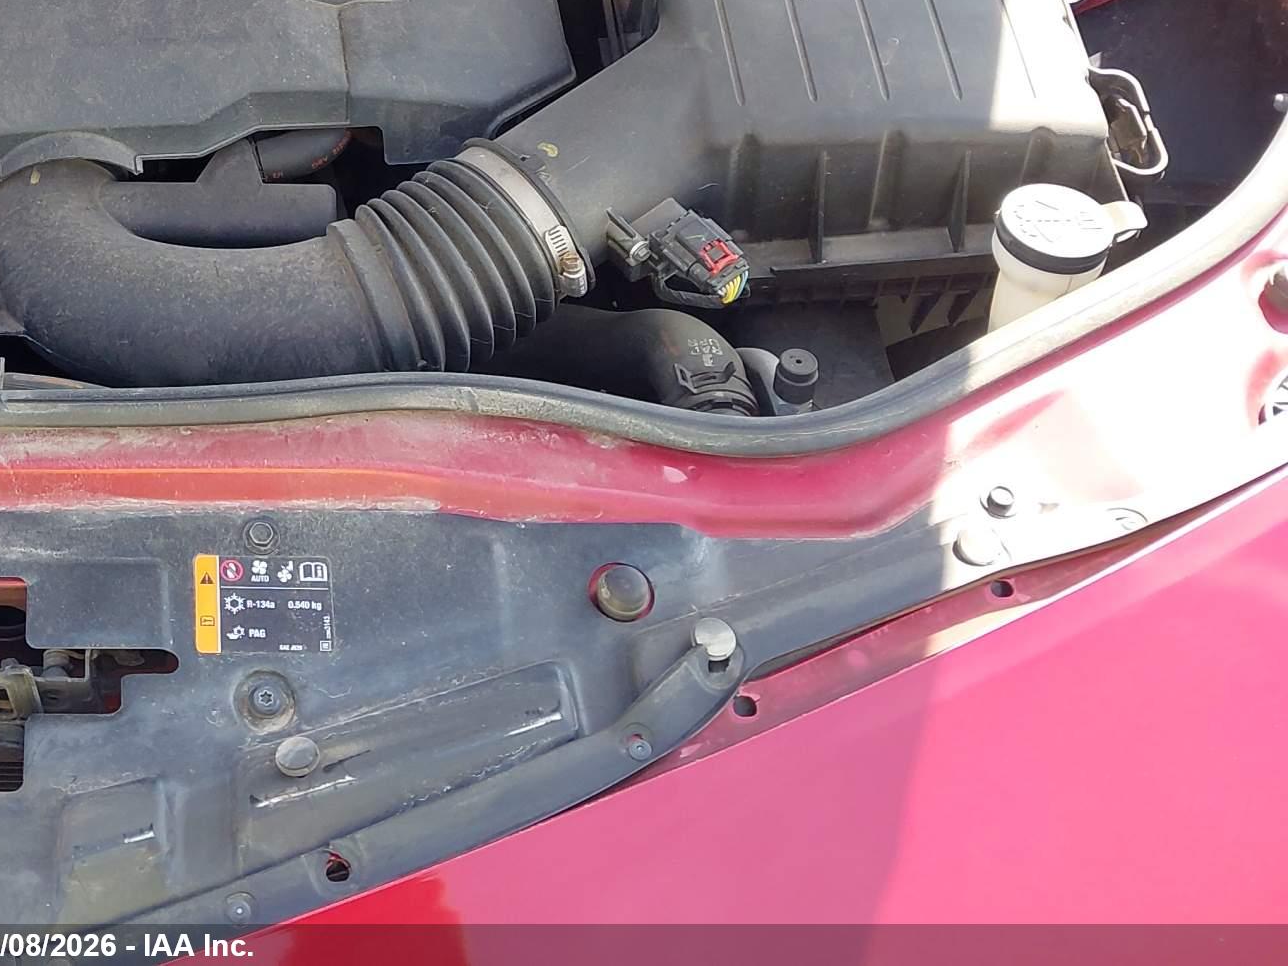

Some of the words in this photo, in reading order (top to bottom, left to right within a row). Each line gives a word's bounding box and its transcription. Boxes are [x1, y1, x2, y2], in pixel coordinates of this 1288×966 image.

[246, 600, 275, 609] R-134a
[288, 600, 310, 609] 0.540
[311, 600, 322, 611] kg
[249, 629, 266, 637] PAG
